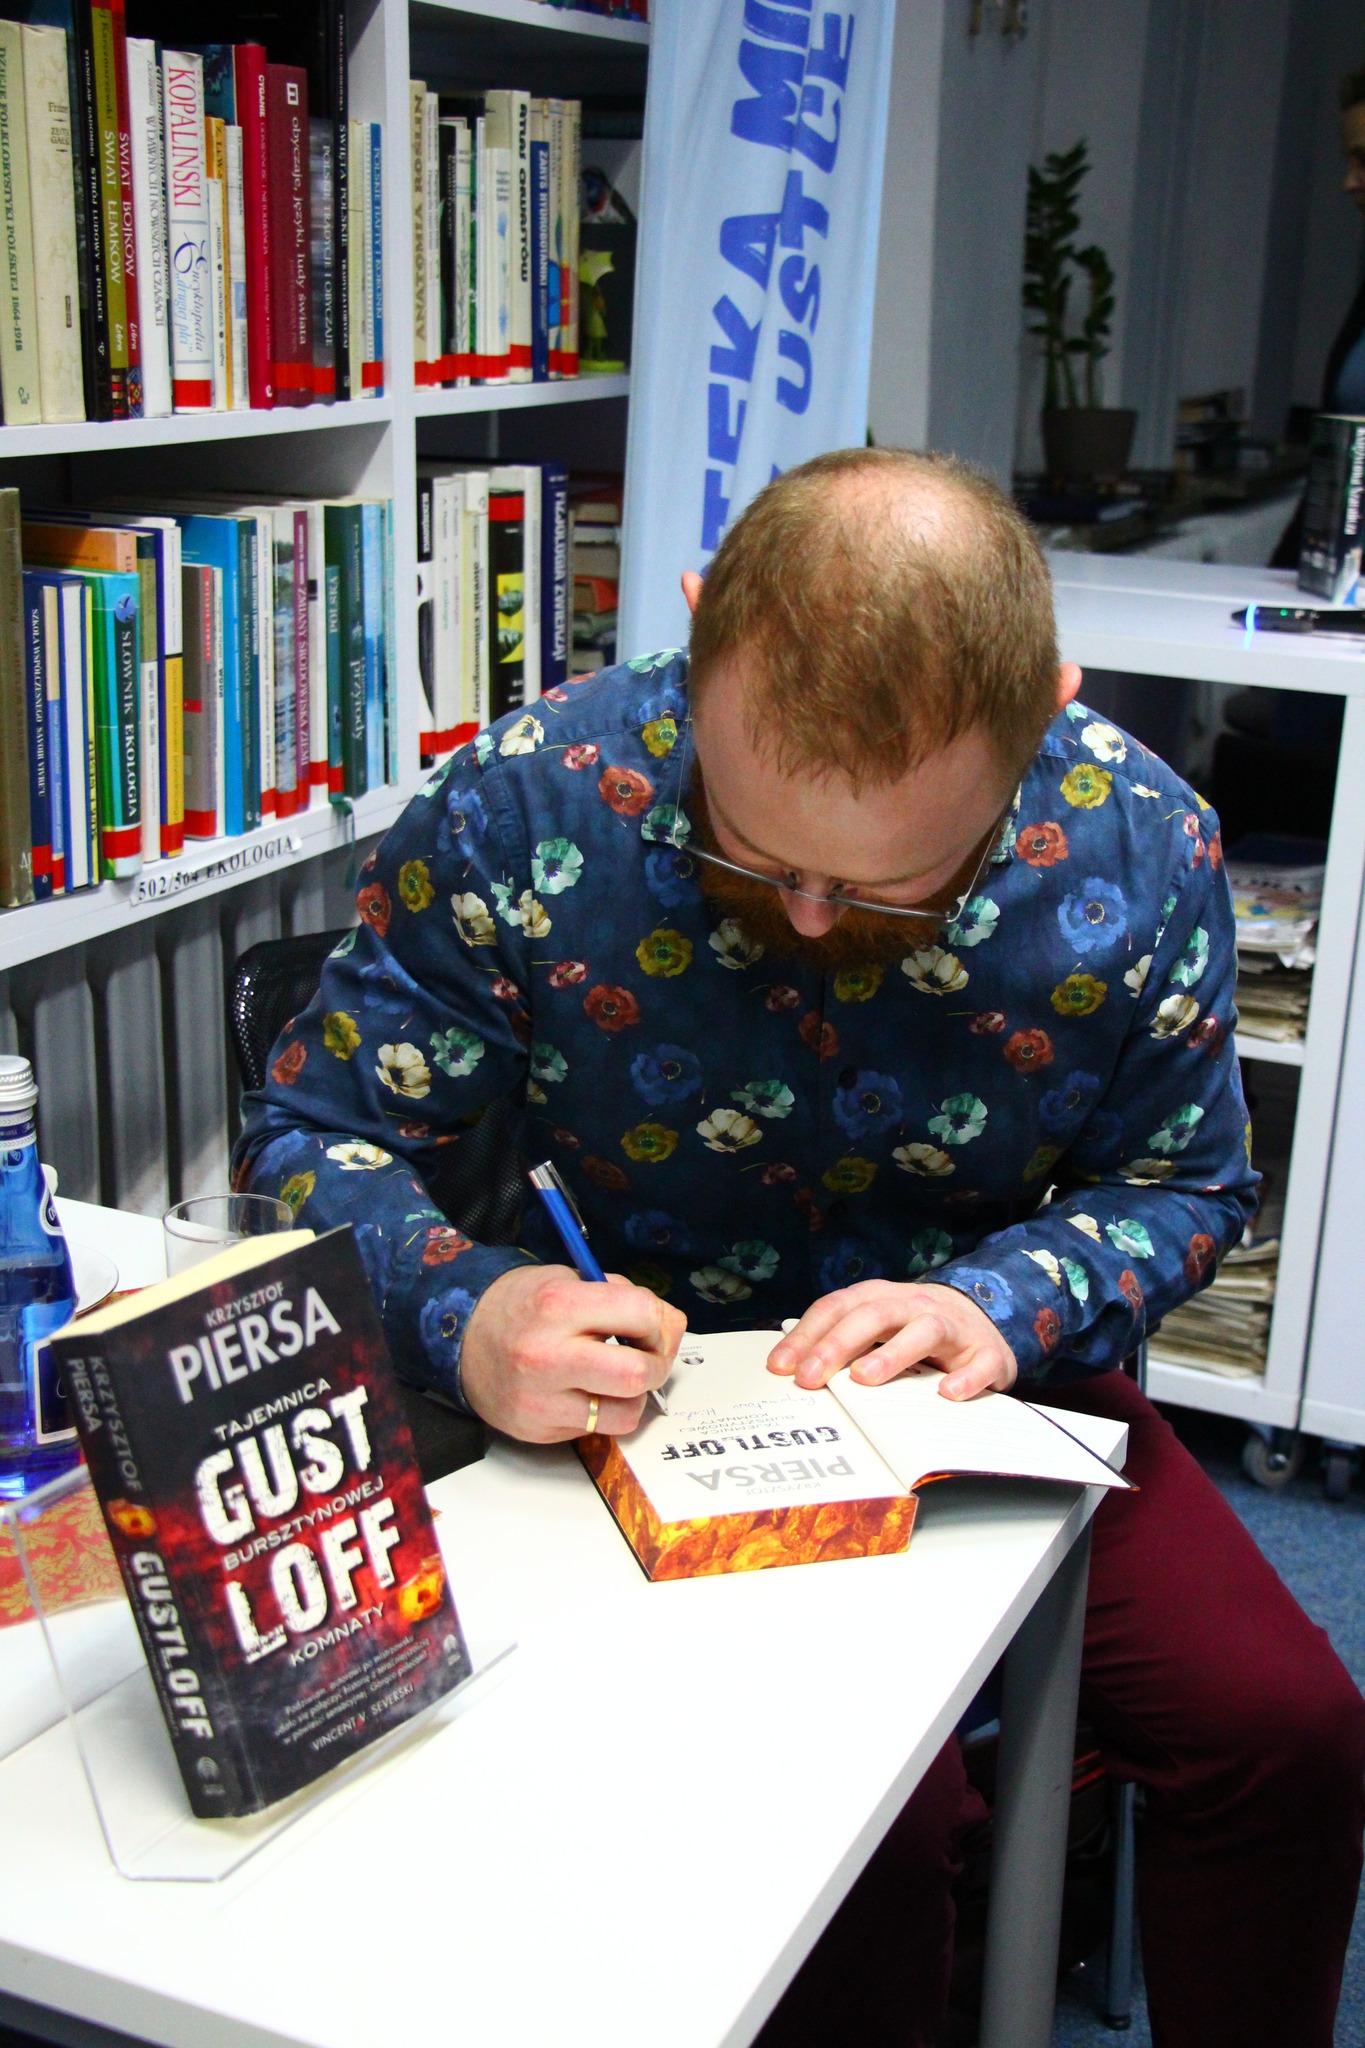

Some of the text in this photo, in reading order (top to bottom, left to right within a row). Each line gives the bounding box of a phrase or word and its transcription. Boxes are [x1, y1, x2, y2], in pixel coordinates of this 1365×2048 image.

[258, 75, 266, 117] CYGANIE
[1, 101, 15, 221] FOLKLORYSTYKI
[87, 106, 95, 157] GADOMSKI
[168, 67, 205, 208] KOPALIŃSKI
[338, 124, 347, 180] ŚWIĘTA
[90, 166, 99, 204] STRÓJ
[322, 145, 331, 199] POLSKIE
[374, 147, 382, 200] POLSKIE
[518, 103, 529, 283] ATLAS CHWASTÓW
[92, 209, 100, 259] LUDOWY
[104, 129, 124, 351] ŚWIAT ŁEMKÓW Libra
[119, 131, 138, 350] ŚWIAT BOJKÓW Libra
[290, 117, 308, 344] obyczaje, języki, ludy świata
[323, 205, 332, 269] TRADYCJE
[340, 187, 349, 247] POLSKIE
[412, 94, 425, 341] ANATOMIA ROŚLIN
[6, 225, 19, 291] POLSKIEJ
[174, 231, 208, 351] Encyklopedia
[375, 259, 383, 319] KORONKI
[12, 295, 24, 351] 1864-1918
[96, 277, 104, 322] POLSCE
[325, 281, 333, 347] OBYCZAJE
[31, 608, 40, 645] SZKOŁA
[298, 587, 308, 638] ZMIANY
[329, 575, 339, 634] POLSKA
[32, 646, 43, 723] WSPÓŁCZESNEGO
[299, 640, 309, 727] ŚRODOWISKA
[349, 660, 366, 740] przyrody
[36, 727, 45, 760] SAVOIR
[121, 631, 138, 818] SŁOWNIK EKOLOGIA
[300, 731, 309, 767] ZIEMI
[205, 835, 294, 880] EKOLOGIA
[205, 1281, 285, 1329] KRZYSZTOF
[167, 1286, 343, 1405] PIERSA
[66, 1358, 99, 1434] PIERSA
[88, 1355, 143, 1494] KRZYSZTOF
[213, 1377, 333, 1443] TAJEMNICA
[193, 1385, 371, 1546] GUST
[660, 1425, 842, 1461] GUSTLOFF
[684, 1454, 856, 1492] PIERSA
[223, 1475, 386, 1573] BURSZTYNOWEJ
[223, 1497, 402, 1666] LOFF
[131, 1551, 213, 1741] GUSTLOFF
[287, 1601, 388, 1668] KOMNATY
[310, 1716, 357, 1752] VINCENT
[370, 1682, 415, 1717] SEVERSKI
